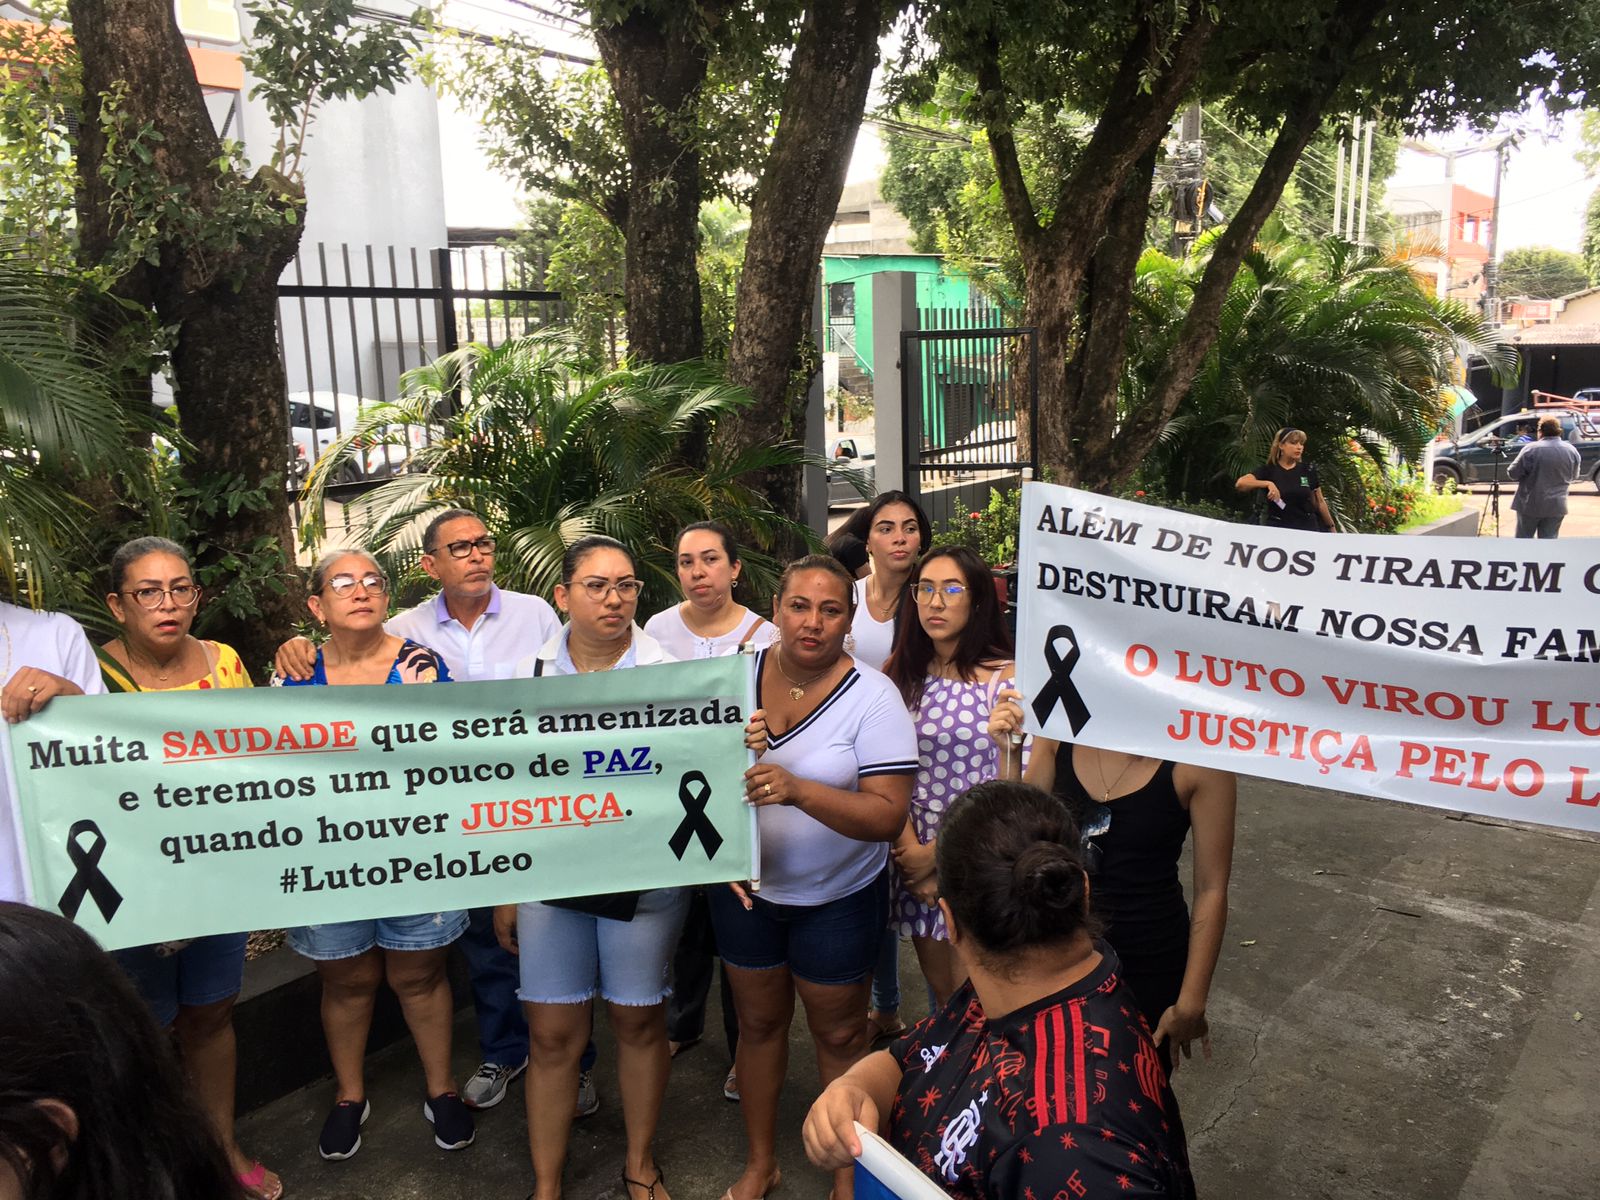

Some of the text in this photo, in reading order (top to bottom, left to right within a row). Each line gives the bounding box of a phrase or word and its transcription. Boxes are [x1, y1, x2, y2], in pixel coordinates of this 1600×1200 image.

[1037, 504, 1143, 546] ALÉM
[1151, 527, 1213, 560] DE
[1223, 541, 1316, 577] NOS
[1333, 553, 1565, 593] TIRAREM
[1037, 562, 1304, 633] DESTRUIRAM
[1315, 608, 1484, 657] NOSSA
[1124, 643, 1159, 677] O
[1174, 650, 1306, 698] LUTO
[1321, 675, 1509, 726] VIROU
[27, 699, 743, 770] Muita SAUDADE que será amenizada
[1167, 709, 1378, 775] JUSTIÇA
[1395, 741, 1545, 798] PELO
[118, 746, 663, 812] e teremos um pouco de PAZ,
[160, 792, 633, 864] quando houver JUSTIÇA.
[279, 850, 533, 894] #LutoPeloLeo
